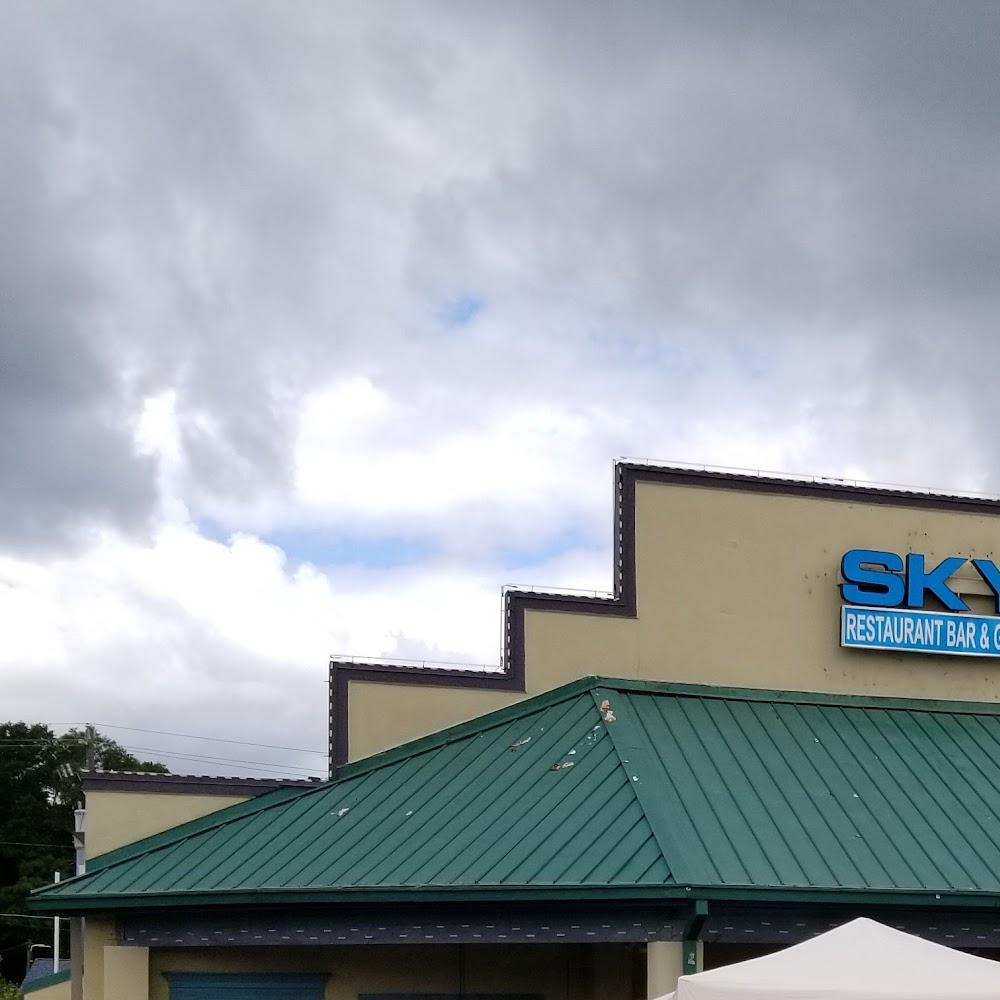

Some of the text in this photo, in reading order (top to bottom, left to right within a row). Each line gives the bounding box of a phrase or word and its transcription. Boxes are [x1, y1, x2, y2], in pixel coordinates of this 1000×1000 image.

[846, 613, 943, 646] RESTAURANT
[946, 620, 976, 649] BAR
[980, 623, 990, 650] &
